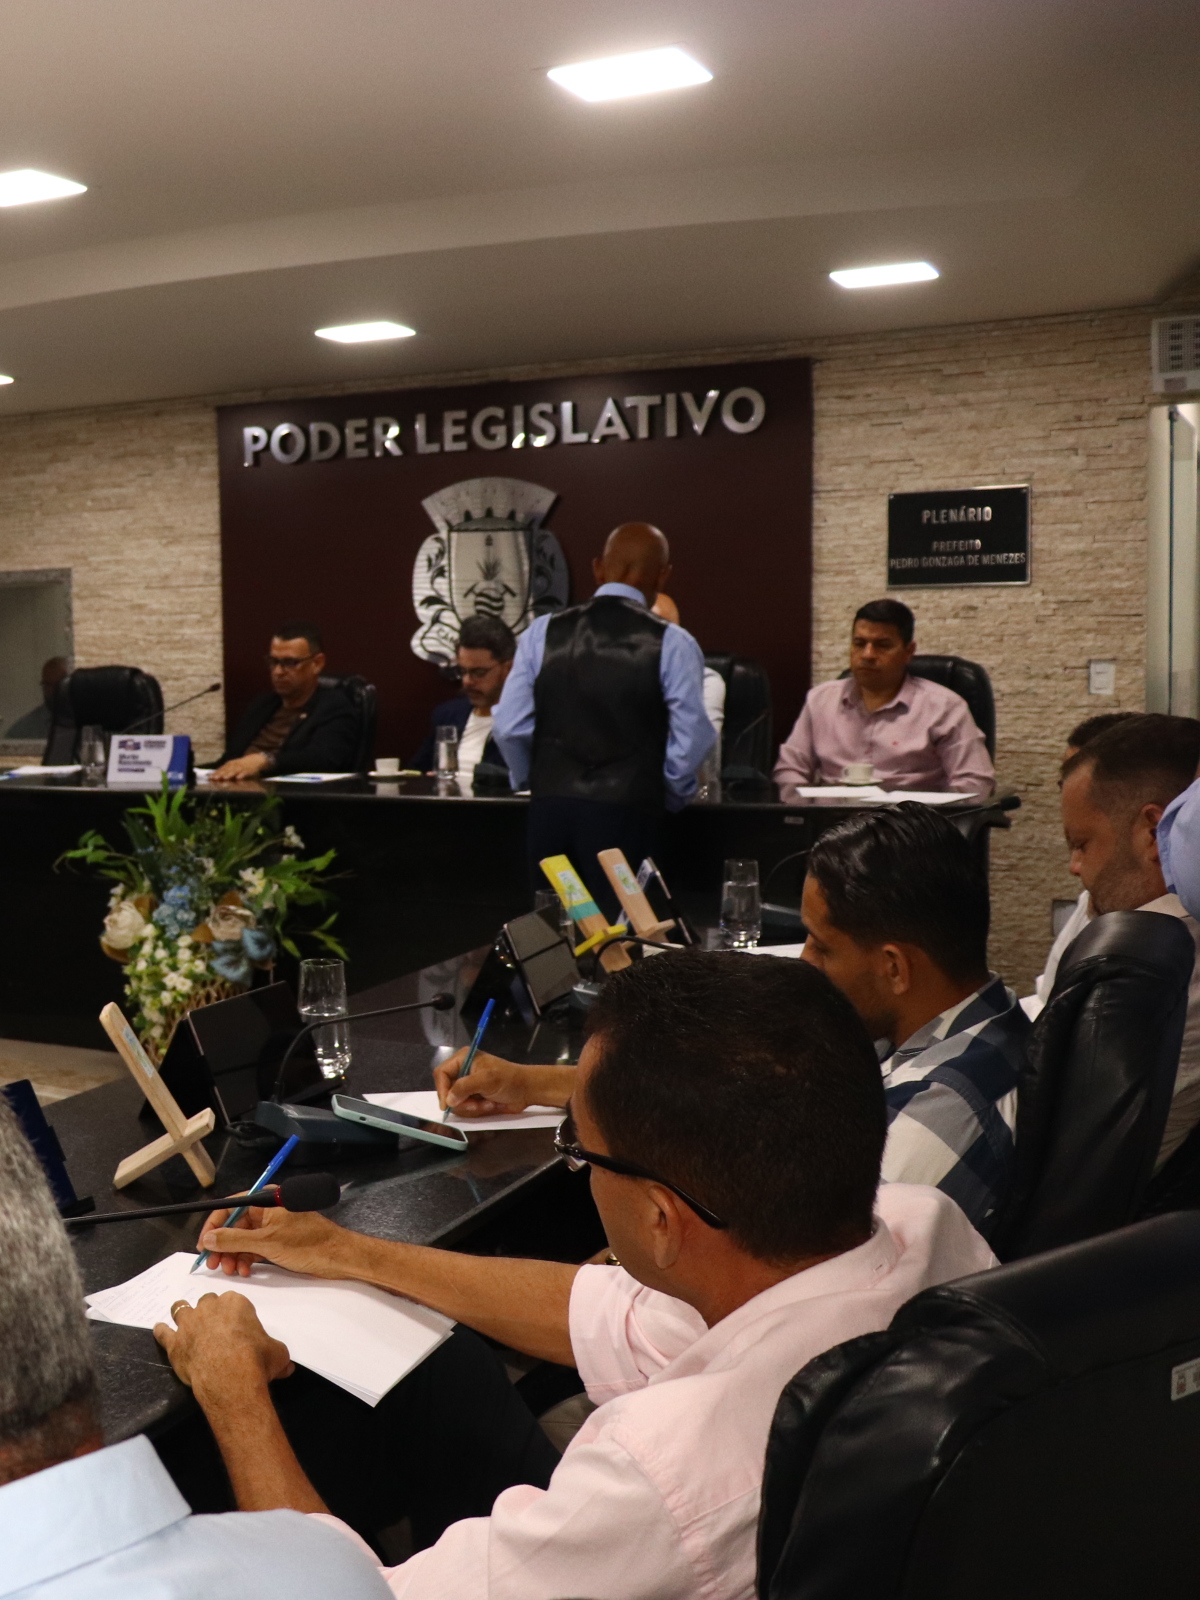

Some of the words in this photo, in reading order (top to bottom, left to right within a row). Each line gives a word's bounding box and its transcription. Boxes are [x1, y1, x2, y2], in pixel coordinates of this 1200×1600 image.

[243, 415, 404, 468] PODER
[414, 386, 766, 455] LEGISLATIVO
[922, 506, 992, 524] PLENÁRIO
[932, 538, 982, 552] PREFEITO
[890, 556, 920, 569] PEDRO
[922, 553, 966, 568] GONZAGA
[968, 553, 980, 566] DE
[981, 551, 1027, 565] MENEZES
